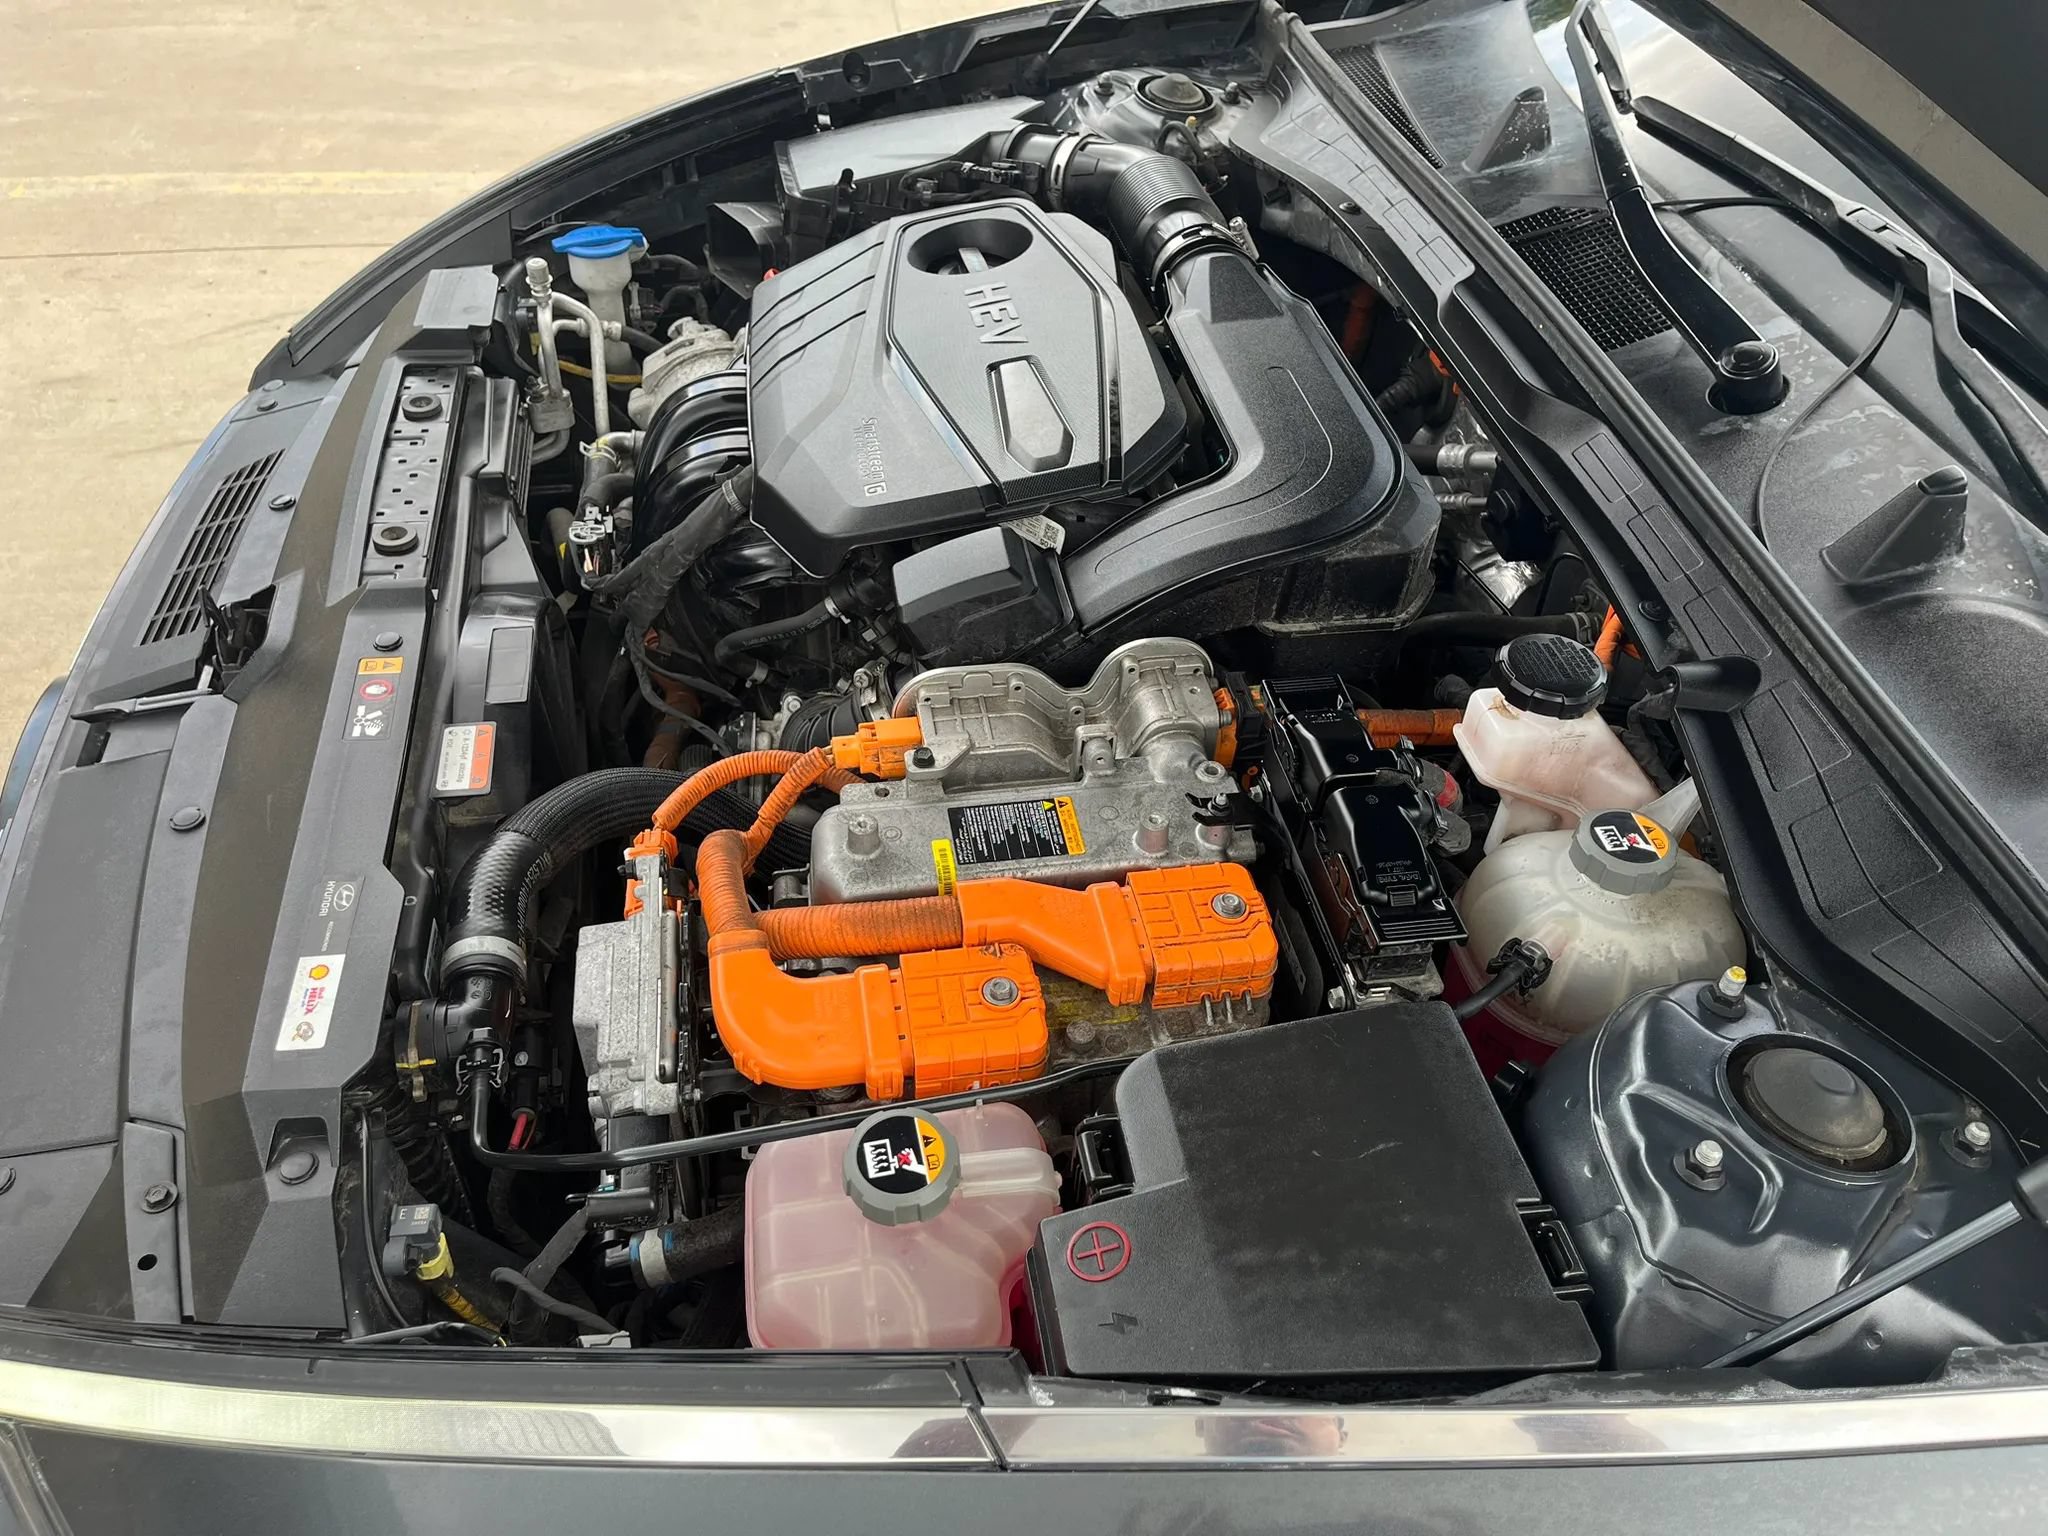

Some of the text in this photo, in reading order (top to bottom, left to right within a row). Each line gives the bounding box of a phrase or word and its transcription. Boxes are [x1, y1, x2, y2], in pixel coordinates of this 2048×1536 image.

[963, 281, 1028, 344] HEV
[862, 416, 887, 497] Smartstream G
[319, 880, 336, 917] HYUNDAI
[304, 987, 319, 1016] HELIX
